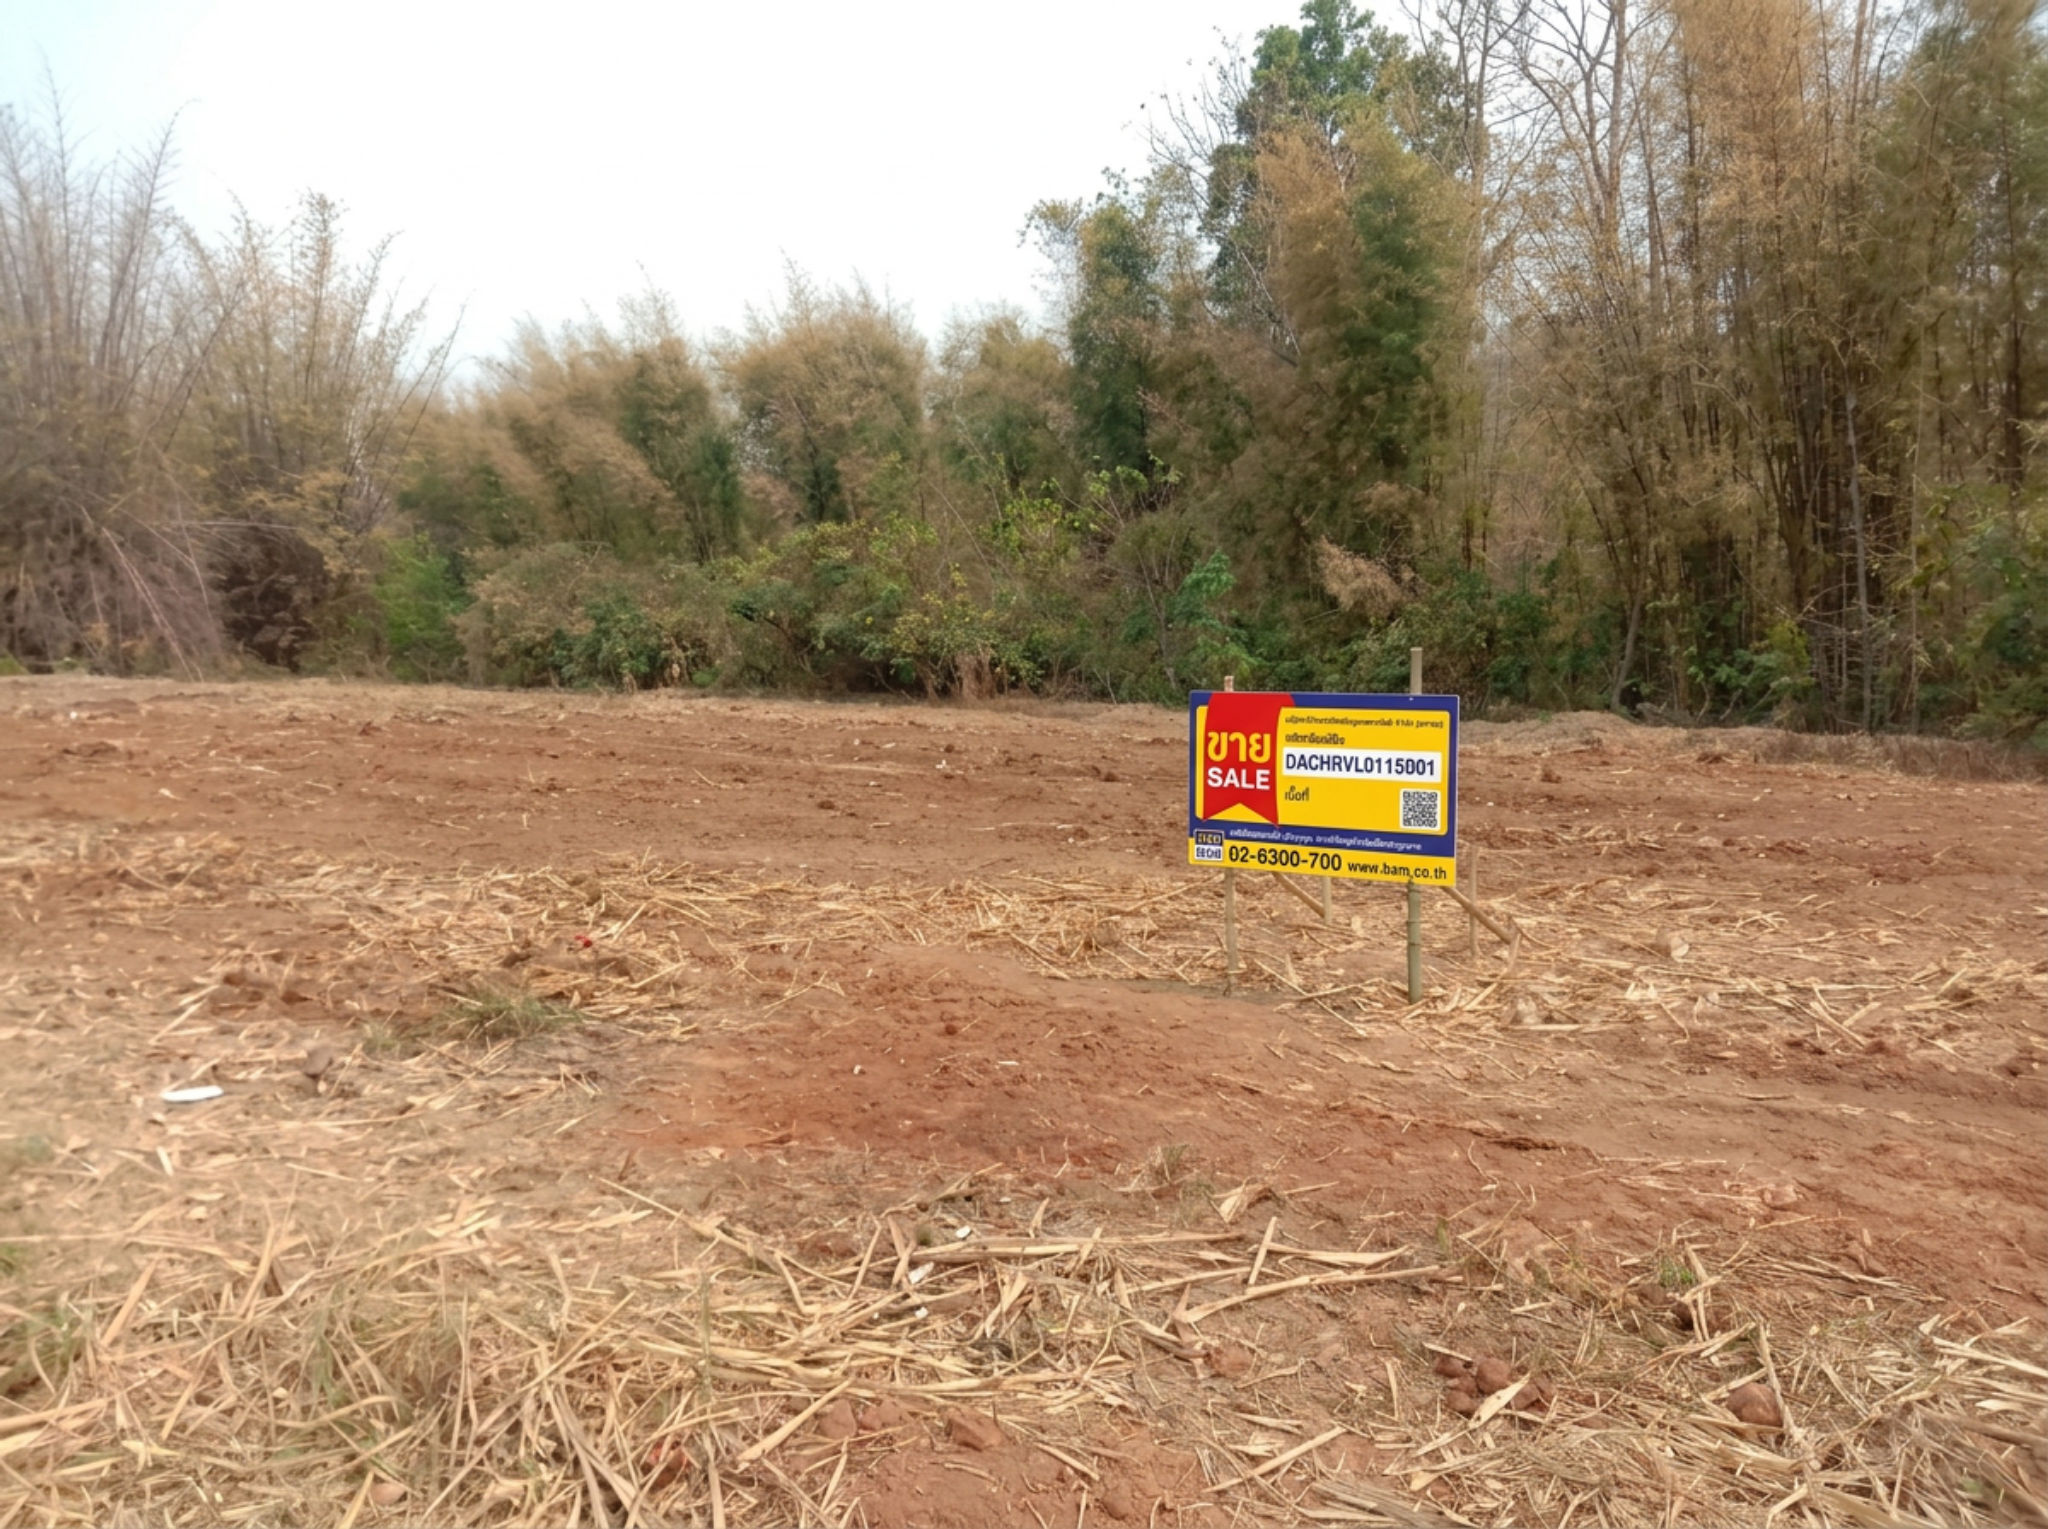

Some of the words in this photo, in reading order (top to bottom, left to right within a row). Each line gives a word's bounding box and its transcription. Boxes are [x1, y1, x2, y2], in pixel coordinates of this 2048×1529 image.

[1207, 731, 1271, 763] ขาย
[1207, 767, 1270, 790] SALE
[1229, 845, 1342, 872] 02-6300-700
